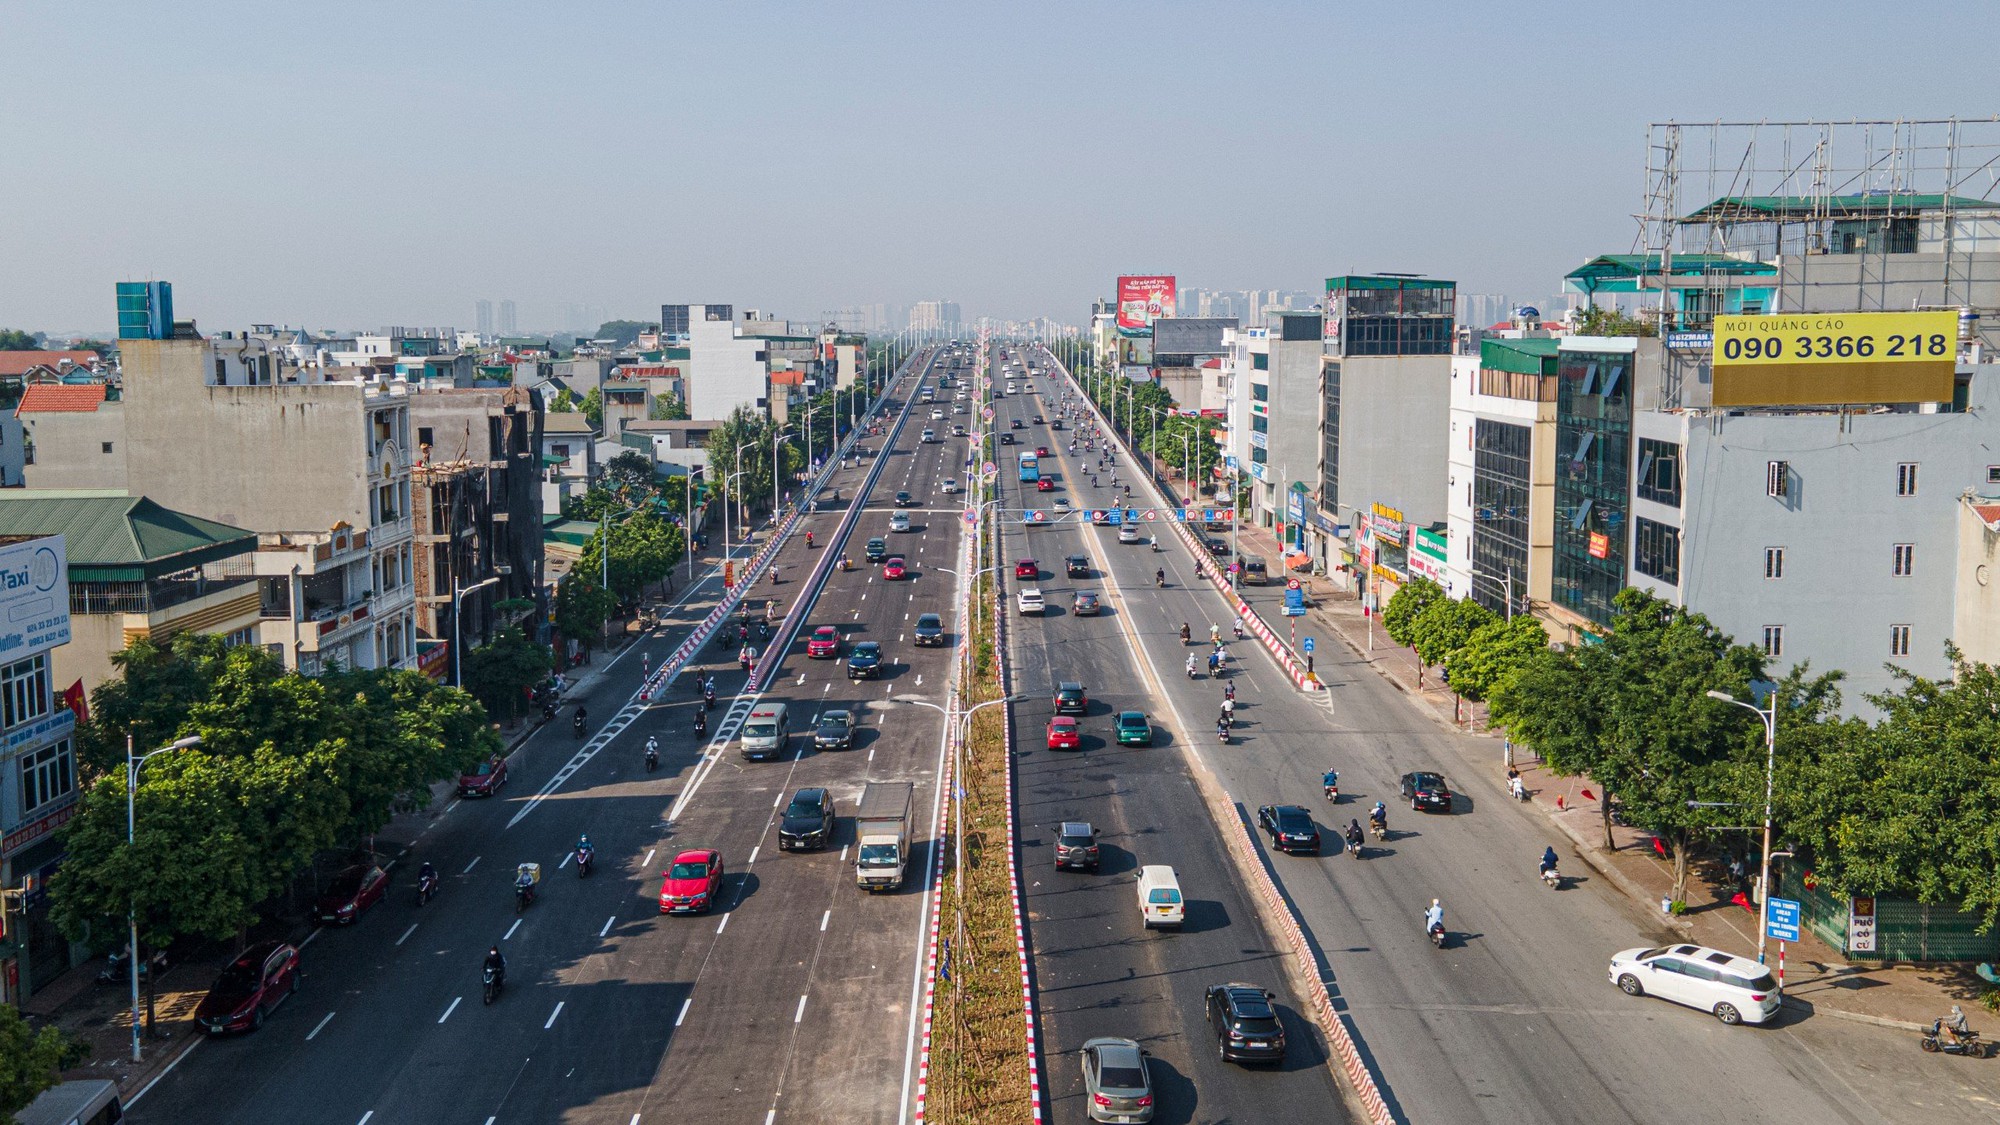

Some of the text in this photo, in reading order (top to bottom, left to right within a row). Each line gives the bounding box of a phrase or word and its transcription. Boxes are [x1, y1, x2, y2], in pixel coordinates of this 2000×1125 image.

[1725, 320, 1753, 332] MỜI
[1815, 318, 1844, 331] CÁO
[1723, 334, 1947, 360] 090 3366 218
[0, 564, 29, 589] Taxi
